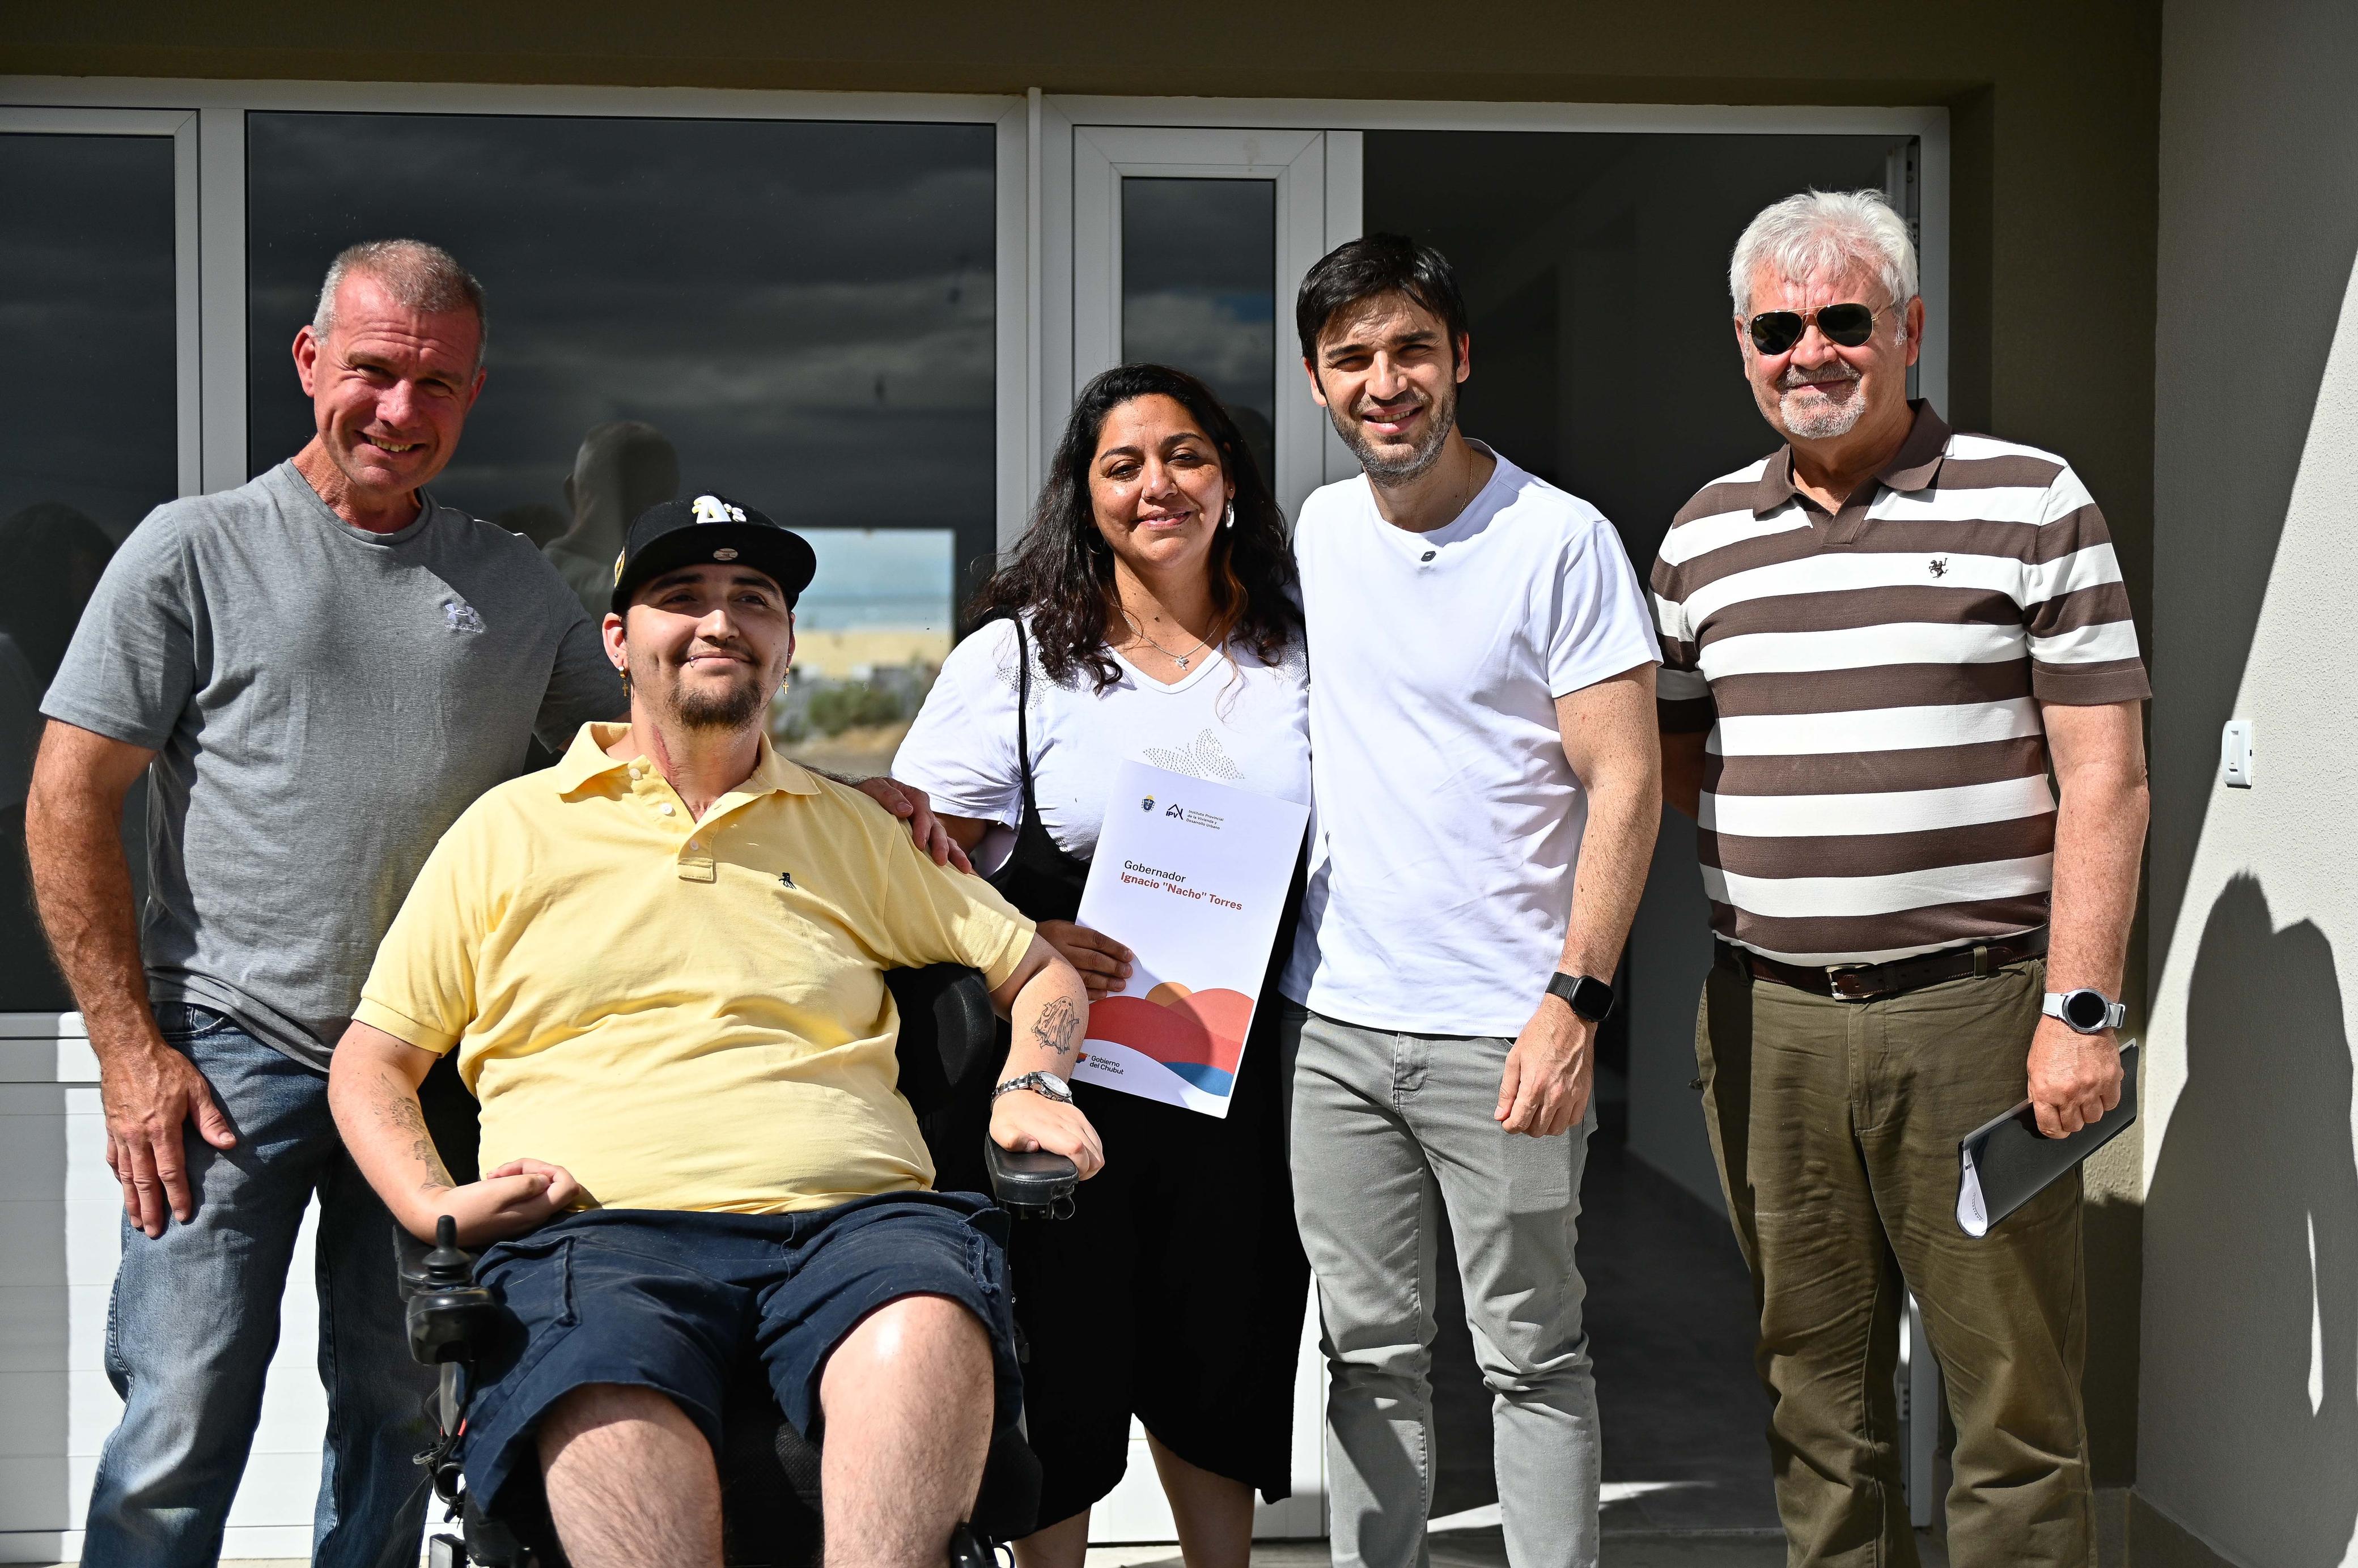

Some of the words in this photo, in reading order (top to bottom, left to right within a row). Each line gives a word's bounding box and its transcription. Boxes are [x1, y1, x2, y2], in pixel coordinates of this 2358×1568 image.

[1186, 818, 1206, 826] Desarrollo
[1124, 860, 1186, 883] Gobernador
[1121, 872, 1160, 889] Ignacio
[1163, 882, 1207, 899] "Nacho"
[1209, 894, 1242, 910] Torres
[1091, 1055, 1120, 1068] Gobierno
[1100, 1064, 1124, 1075] Chubut
